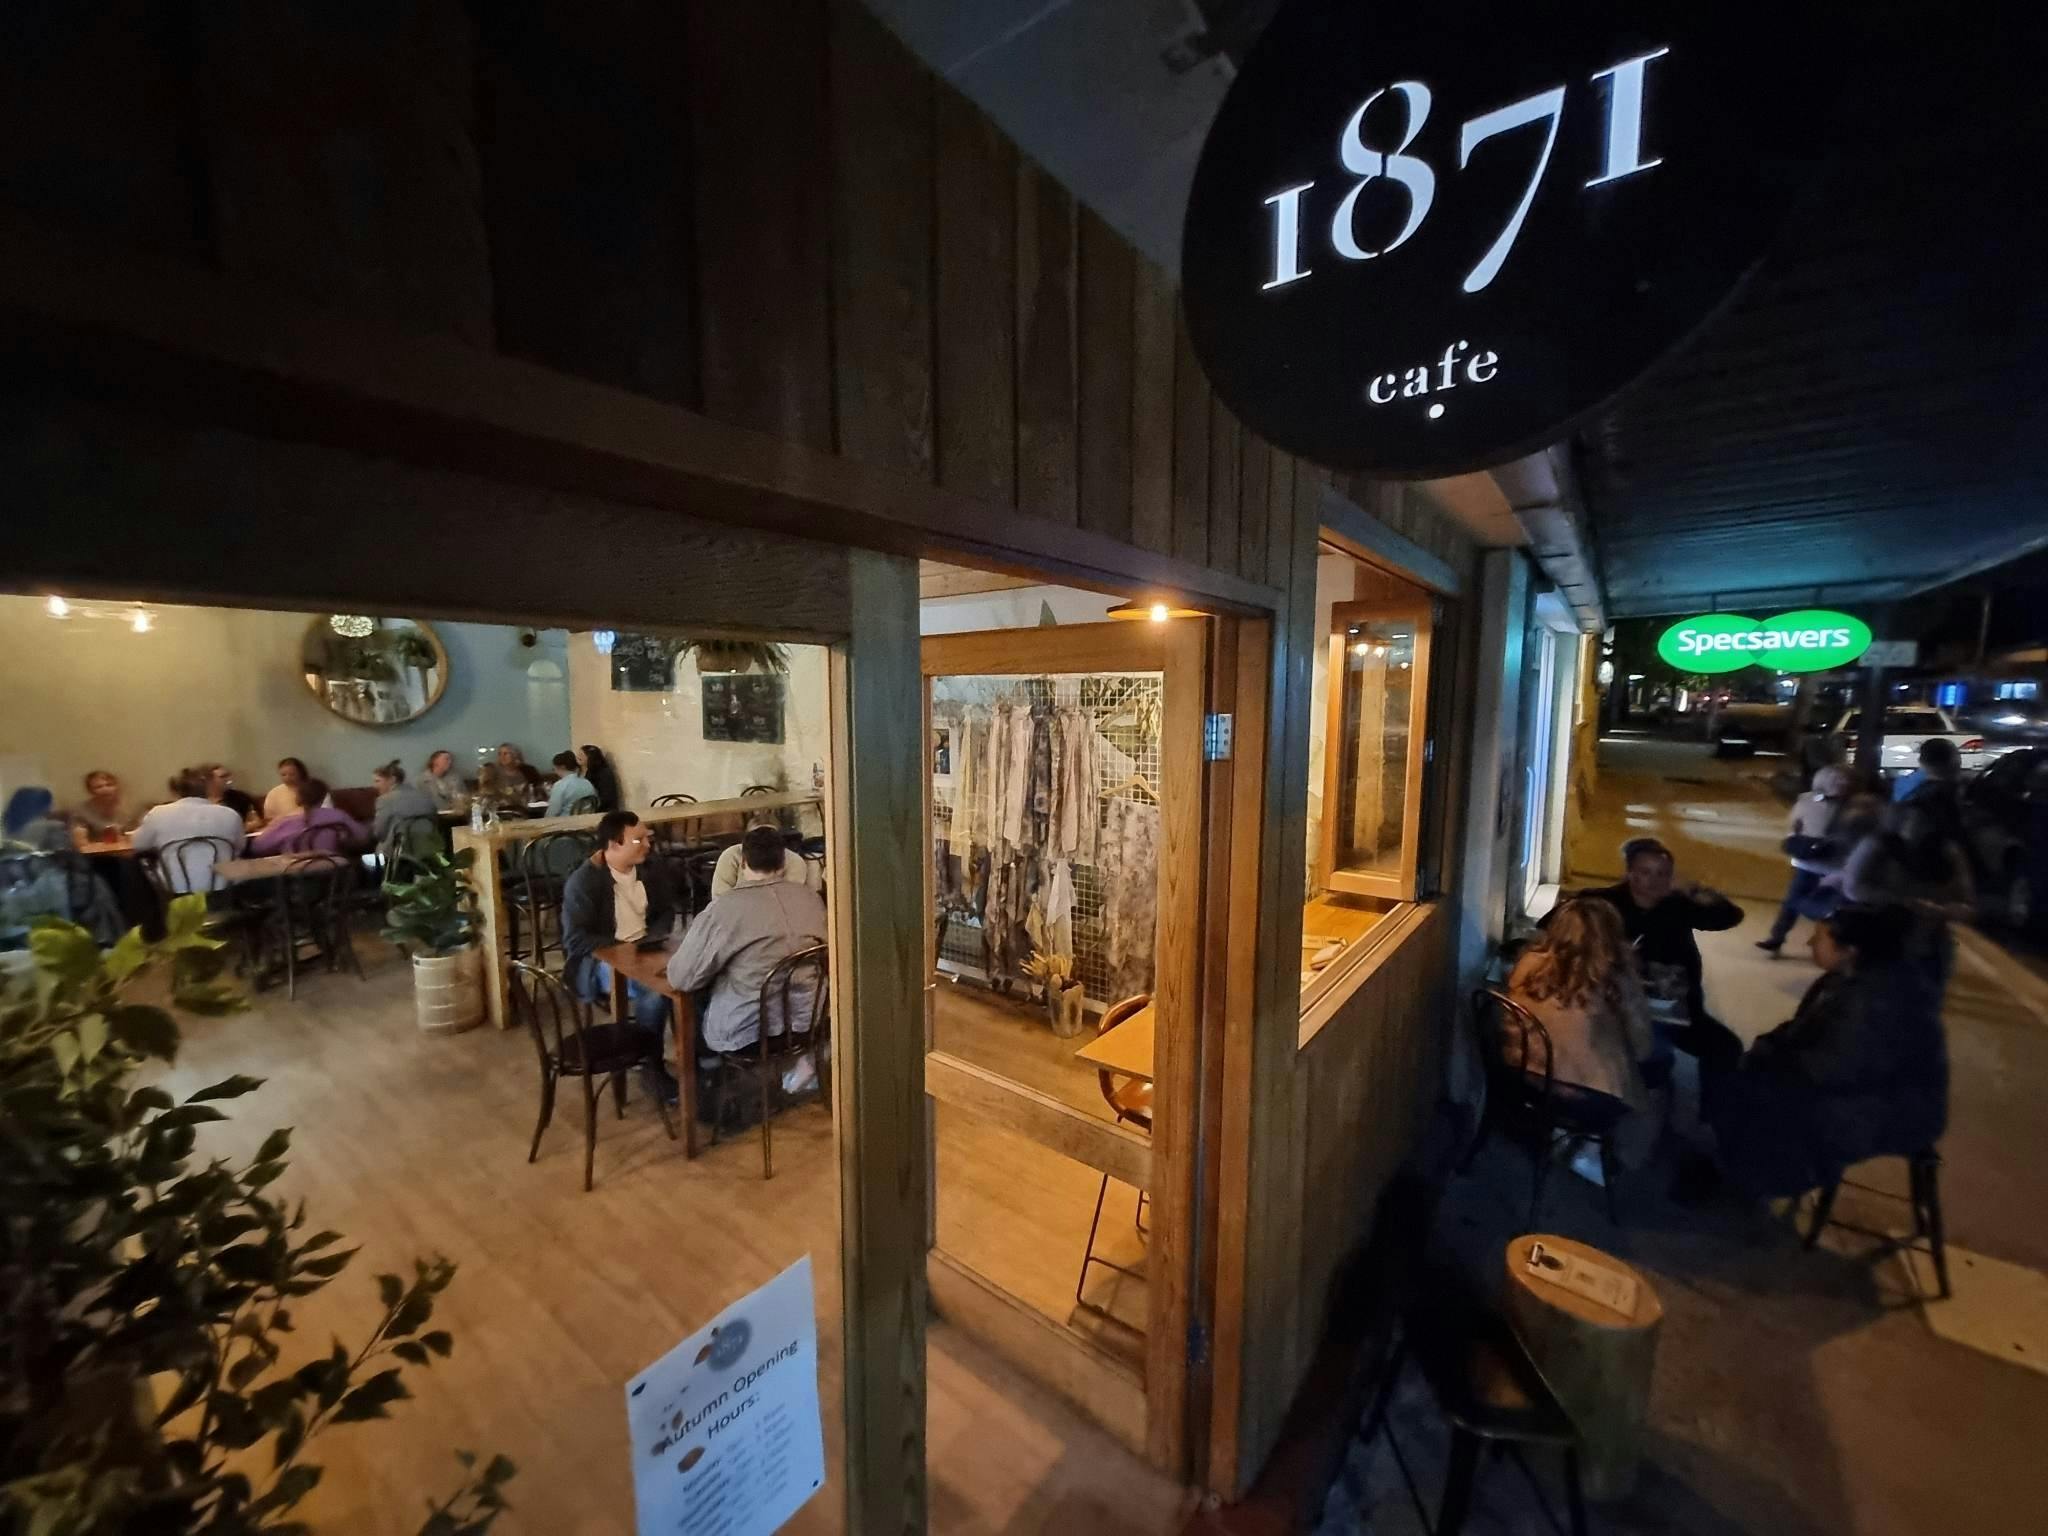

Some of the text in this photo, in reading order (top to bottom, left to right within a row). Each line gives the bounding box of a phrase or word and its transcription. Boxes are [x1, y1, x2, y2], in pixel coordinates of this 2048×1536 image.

[1261, 46, 1671, 293] 1871
[1368, 339, 1499, 404] cafe
[1677, 627, 1851, 656] Specsavers
[661, 1391, 729, 1453] Autumn
[733, 1340, 799, 1393] Opening
[707, 1391, 761, 1440] Hours:
